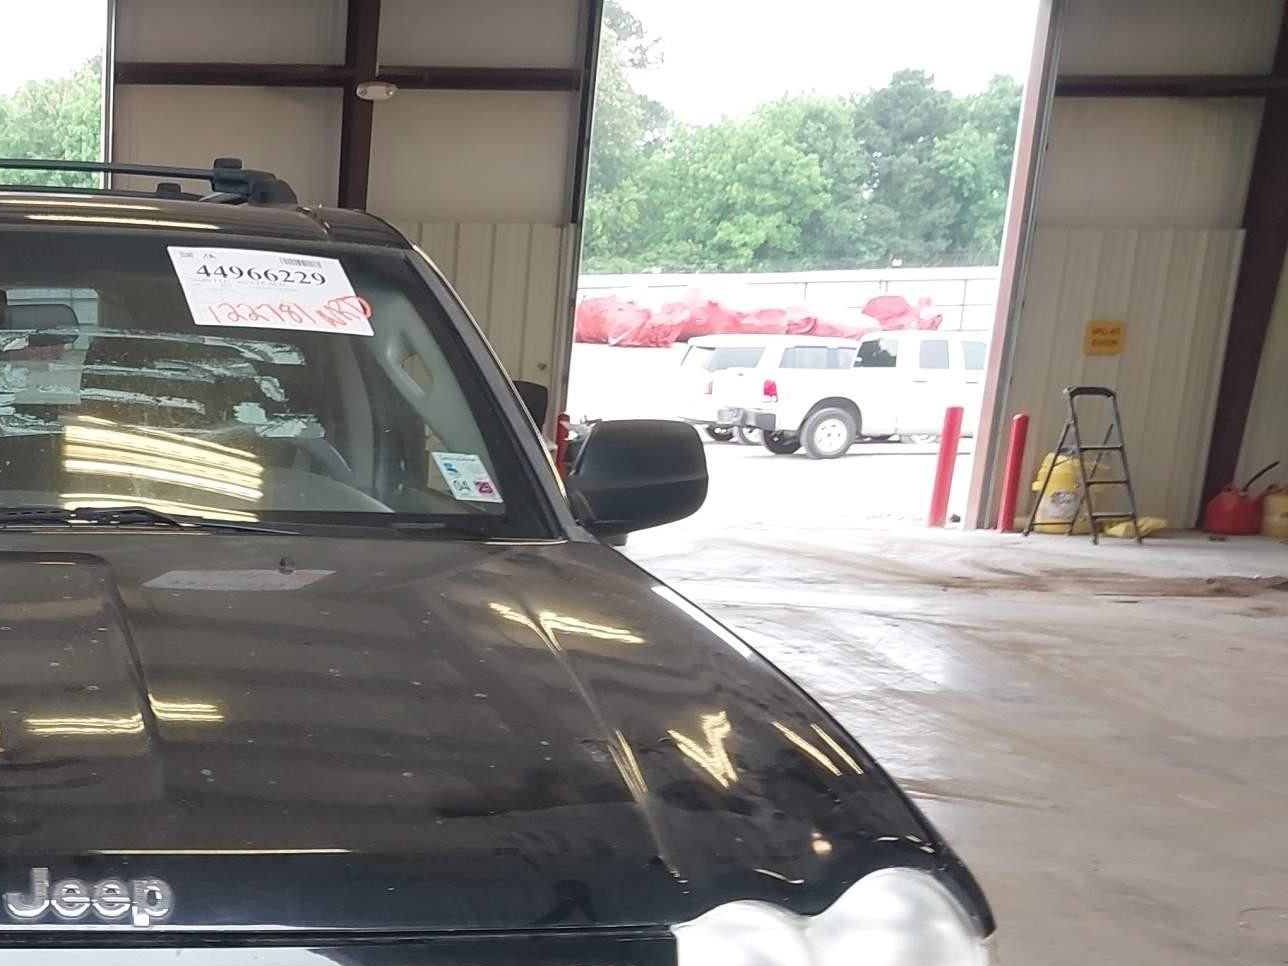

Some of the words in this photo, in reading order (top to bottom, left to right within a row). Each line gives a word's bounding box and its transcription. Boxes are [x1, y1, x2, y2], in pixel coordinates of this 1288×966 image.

[196, 263, 326, 286] 44966229
[208, 302, 316, 325] 122781
[2, 867, 174, 927] Jeep
